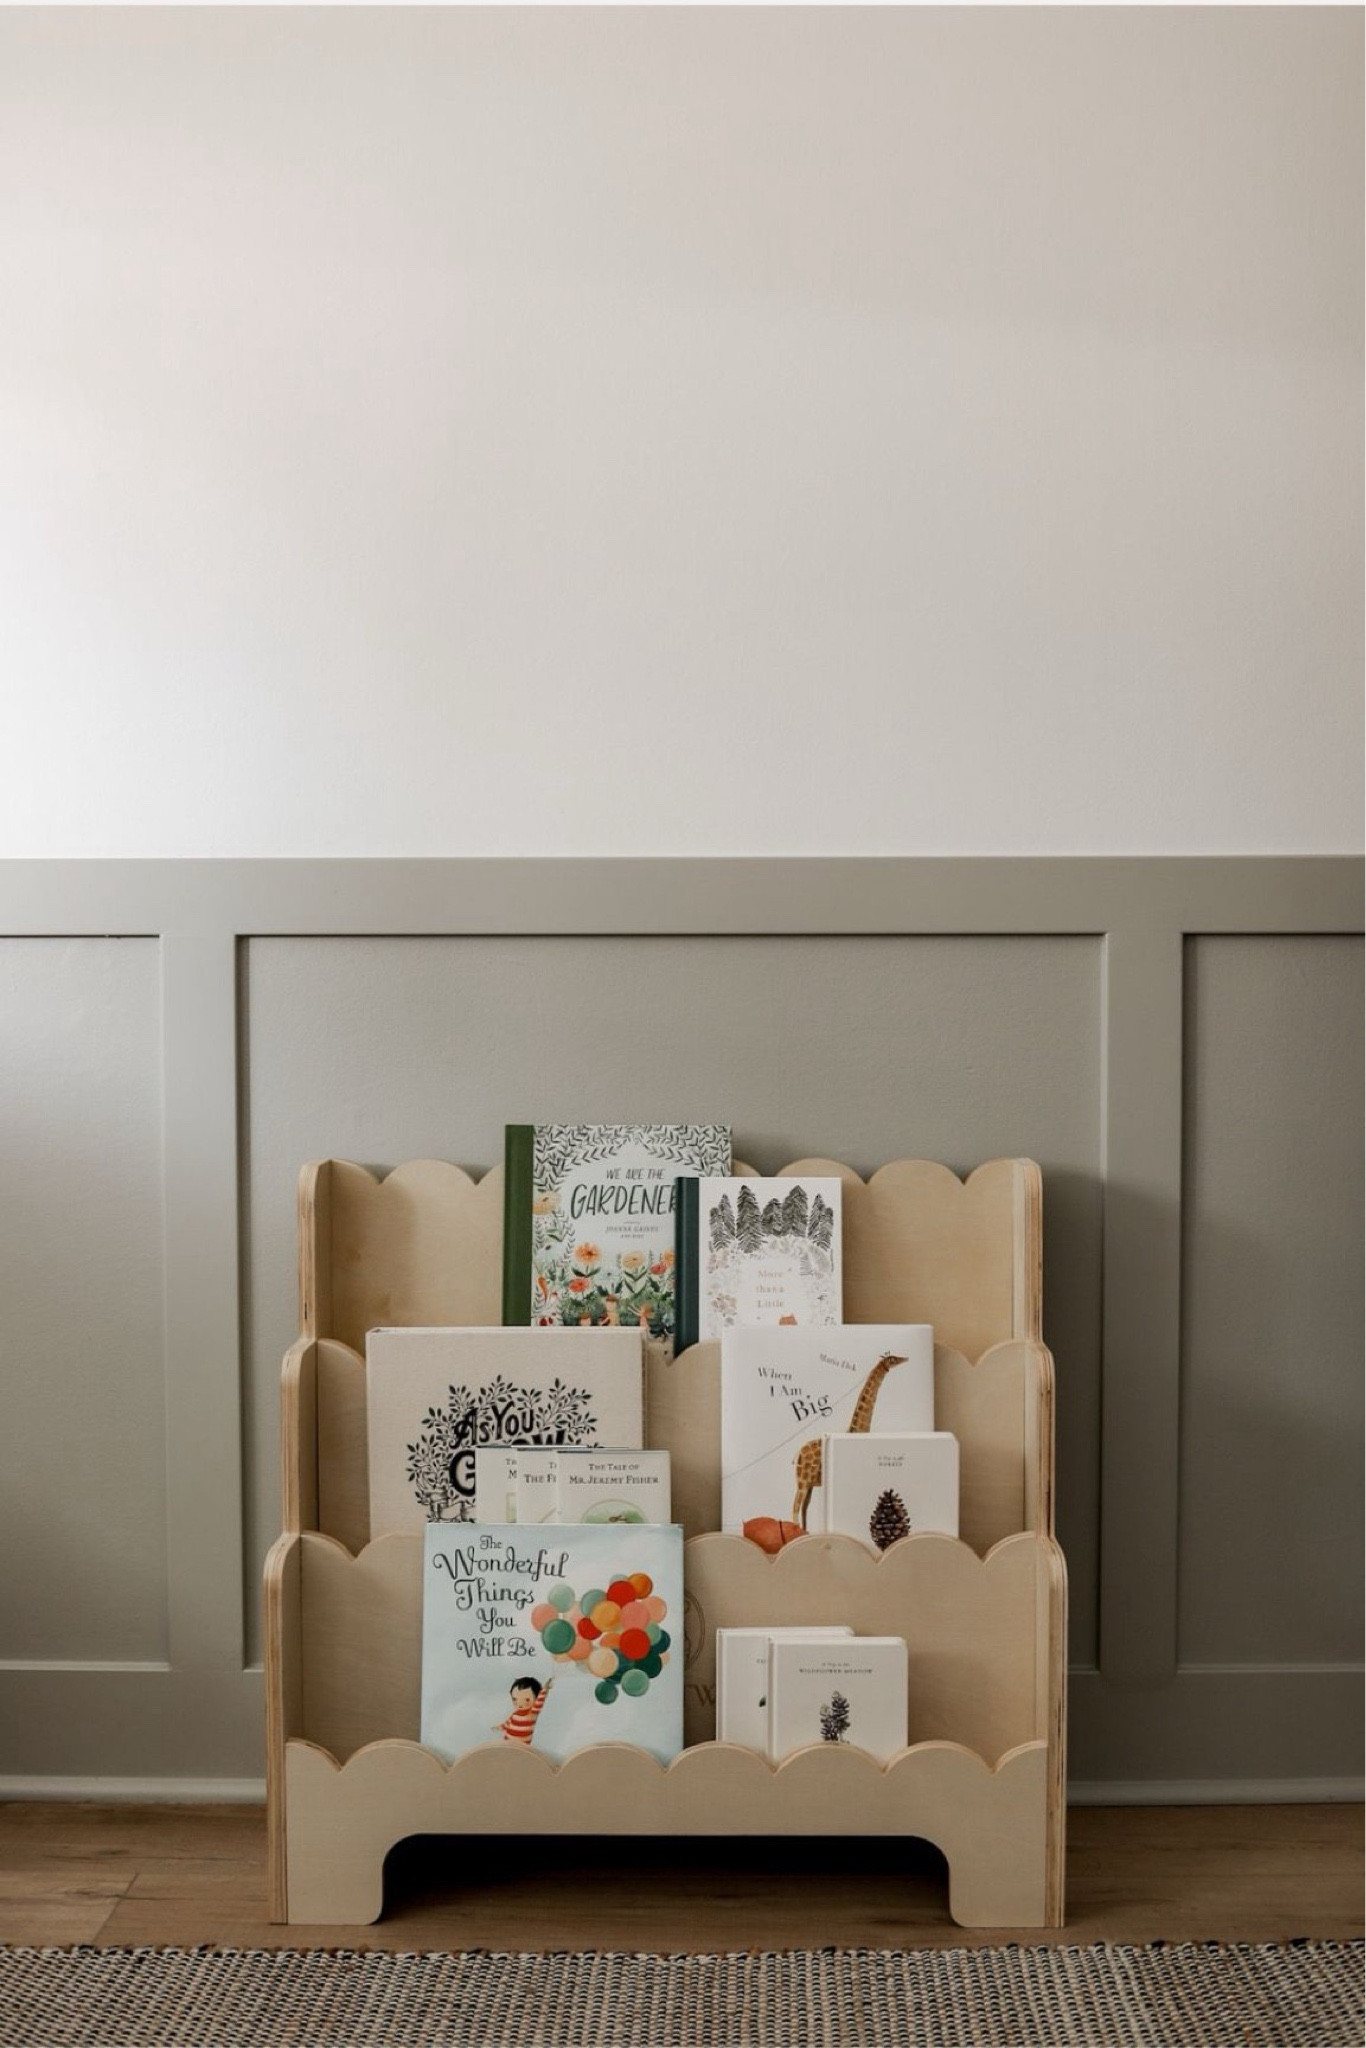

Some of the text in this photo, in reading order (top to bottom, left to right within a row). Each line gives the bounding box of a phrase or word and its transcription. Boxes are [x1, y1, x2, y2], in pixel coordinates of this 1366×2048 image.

[606, 1168, 666, 1180] WE ARE THE
[758, 1367, 792, 1380] When
[781, 1384, 802, 1396] Am
[790, 1394, 833, 1422] Big
[479, 1535, 502, 1550] The
[433, 1545, 569, 1582] Wonderful
[454, 1577, 535, 1611] Things
[476, 1607, 516, 1634] You
[456, 1637, 537, 1658] Will Be
